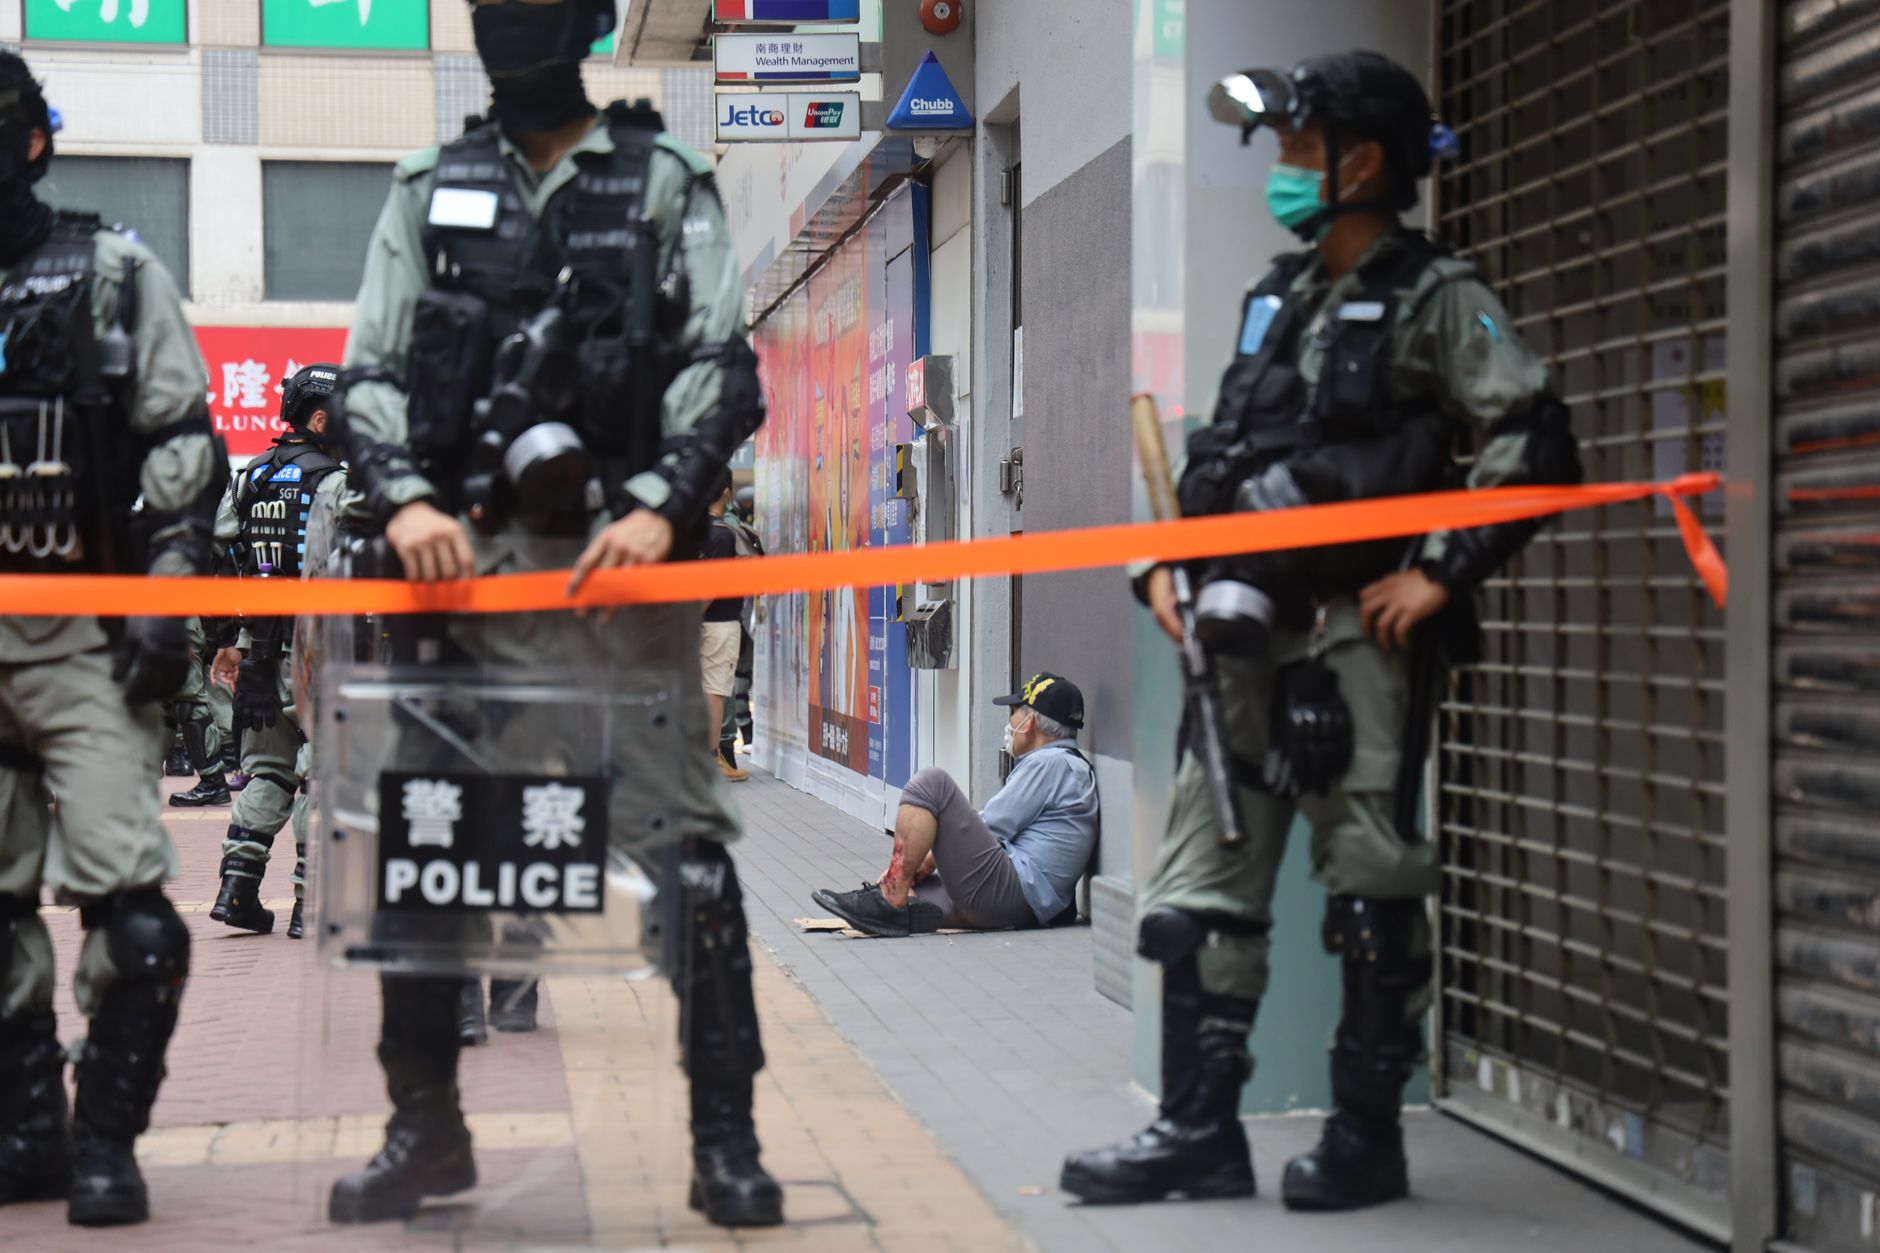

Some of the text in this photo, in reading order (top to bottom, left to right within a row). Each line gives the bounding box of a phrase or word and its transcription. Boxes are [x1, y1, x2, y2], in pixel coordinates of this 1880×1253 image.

[755, 42, 803, 54] 南商理財
[755, 55, 854, 67] Wealth Management
[910, 98, 954, 110] Chubb
[808, 108, 841, 117] UnionPay
[310, 370, 337, 381] POLICE
[279, 488, 299, 499] SGT
[402, 778, 586, 849] 警察
[384, 857, 600, 908] POLICE
